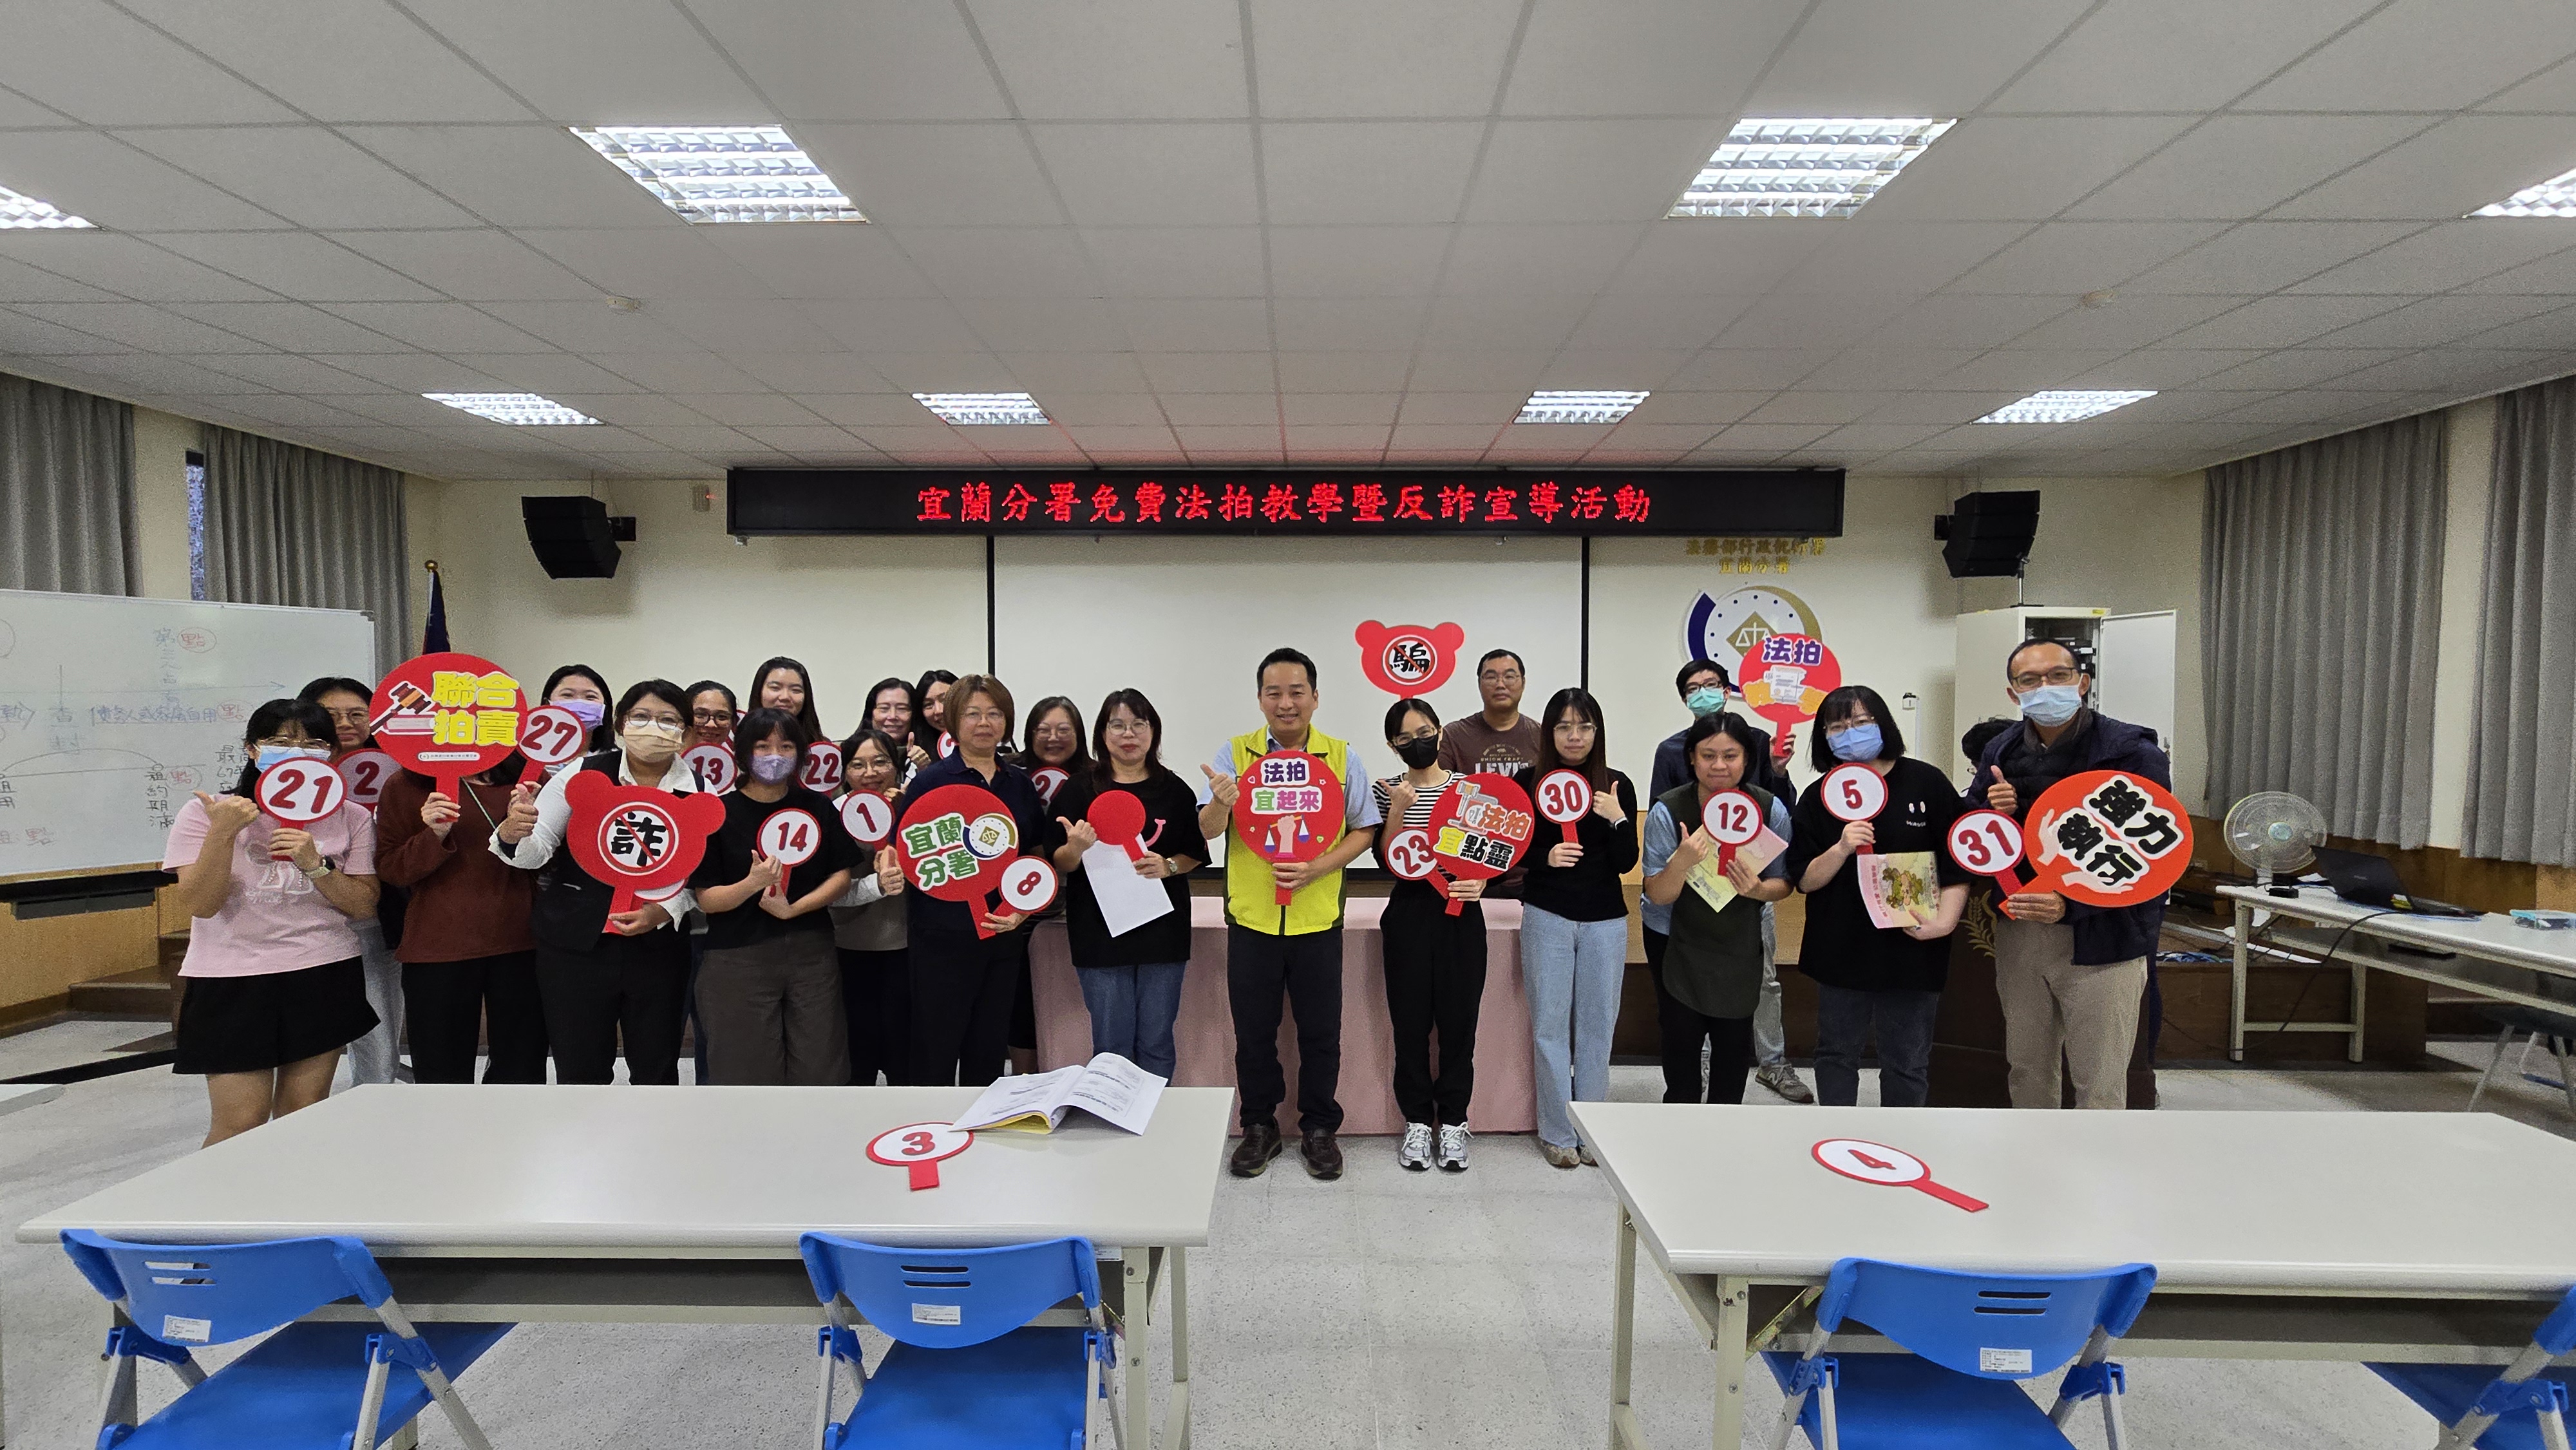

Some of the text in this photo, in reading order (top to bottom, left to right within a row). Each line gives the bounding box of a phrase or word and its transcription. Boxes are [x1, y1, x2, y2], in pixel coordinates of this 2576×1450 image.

[916, 480, 1651, 523] 宜蘭分署免費法拍教學暨反詐宣導活動
[1389, 642, 1430, 674] 騙
[1763, 637, 1821, 664] 法拍
[432, 672, 519, 708] 聯合
[433, 710, 519, 745] 拍賣
[521, 715, 577, 757] 27
[692, 755, 723, 785] 13
[804, 752, 840, 785] 22
[1264, 760, 1306, 784] 法拍
[268, 768, 334, 814] 21
[1255, 789, 1320, 811] 宜起來
[1546, 780, 1582, 814] 30
[1842, 778, 1863, 809] 5
[857, 802, 877, 833] 1
[1478, 804, 1531, 839] 法拍
[1718, 802, 1748, 833] 12
[2088, 779, 2179, 854] 強力
[611, 811, 667, 867] 詐
[777, 821, 808, 851] 14
[905, 816, 961, 856] 宜蘭
[1435, 827, 1513, 870] 宜點靈
[1958, 820, 2015, 867] 31
[2058, 813, 2143, 885] 執行
[918, 848, 978, 887] 分署
[1392, 834, 1435, 875] 23
[1016, 871, 1042, 896] 8
[902, 1131, 936, 1155] 3
[1847, 1149, 1897, 1170] 4
